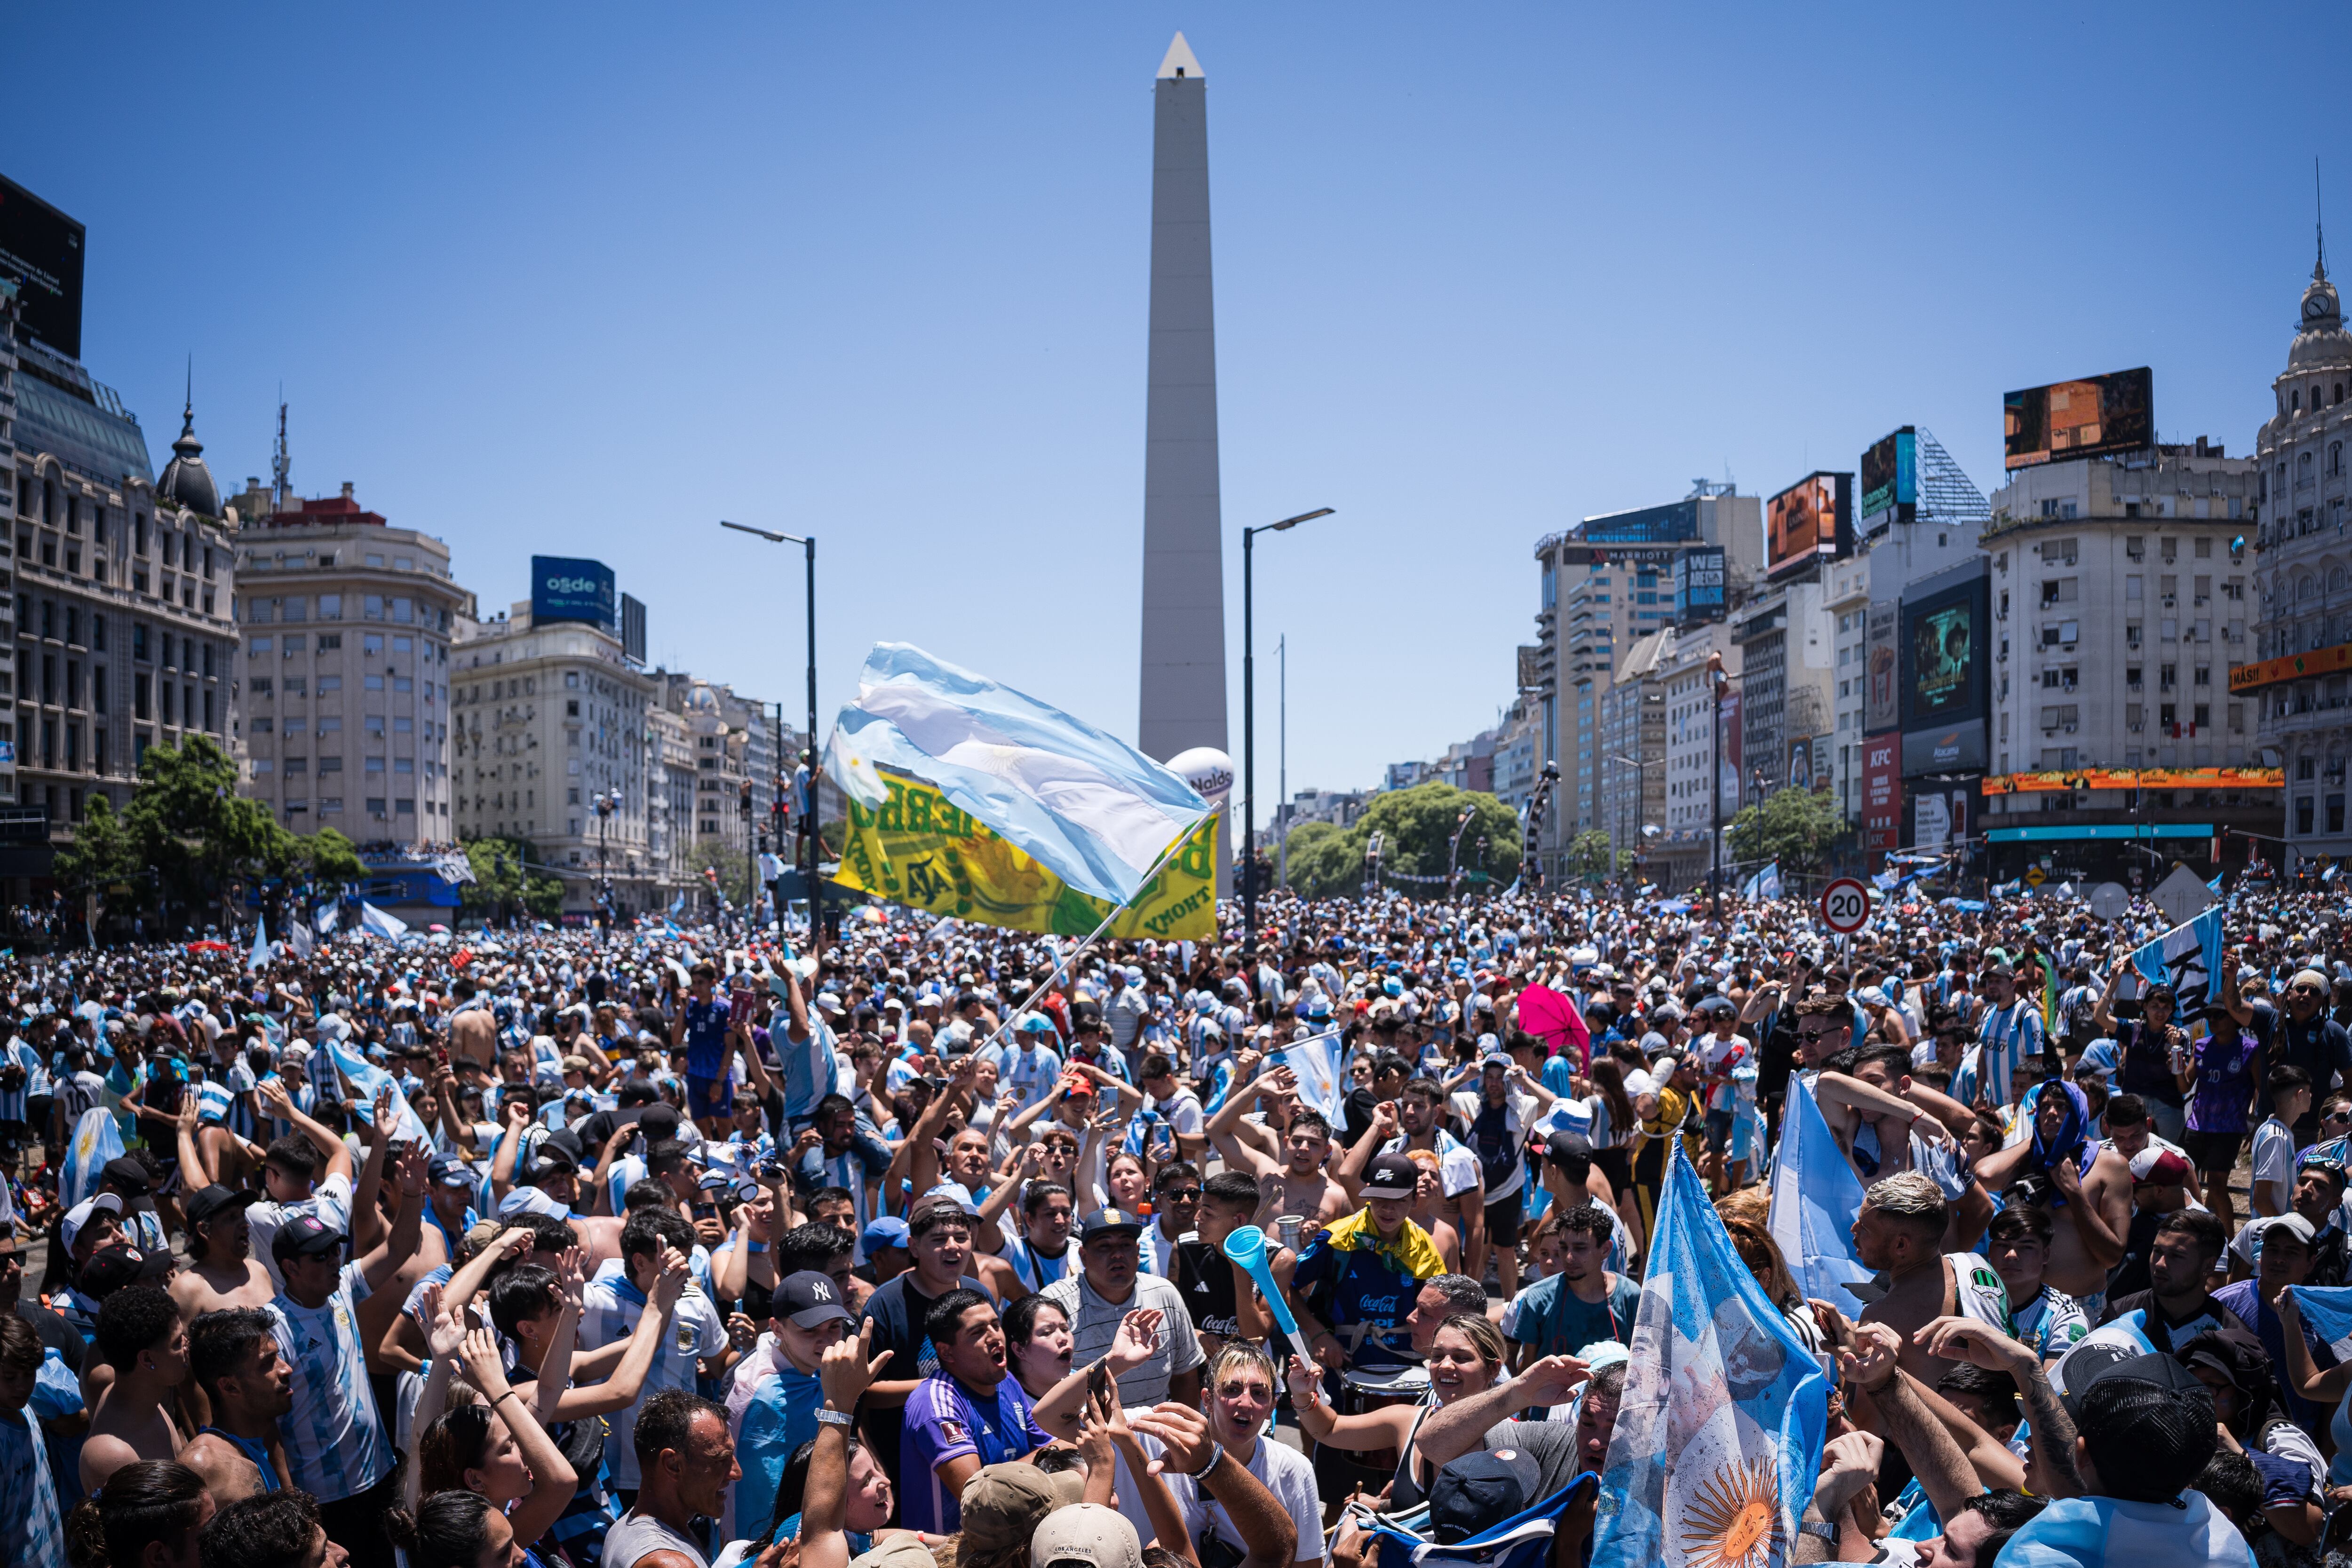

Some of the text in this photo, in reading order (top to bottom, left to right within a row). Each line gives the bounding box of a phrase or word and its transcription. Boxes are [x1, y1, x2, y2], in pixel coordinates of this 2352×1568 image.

[1609, 551, 1669, 561] MARRIOTT
[1690, 554, 1724, 570] WE
[1870, 748, 1891, 768] KFC
[1190, 770, 1232, 791] Naldo
[1870, 833, 1885, 846] KFC
[1831, 895, 1861, 918] 20
[2208, 1069, 2221, 1083] 10
[321, 1083, 336, 1102] 5
[812, 1281, 832, 1301] NY
[1454, 1524, 1471, 1535] HILFIGER
